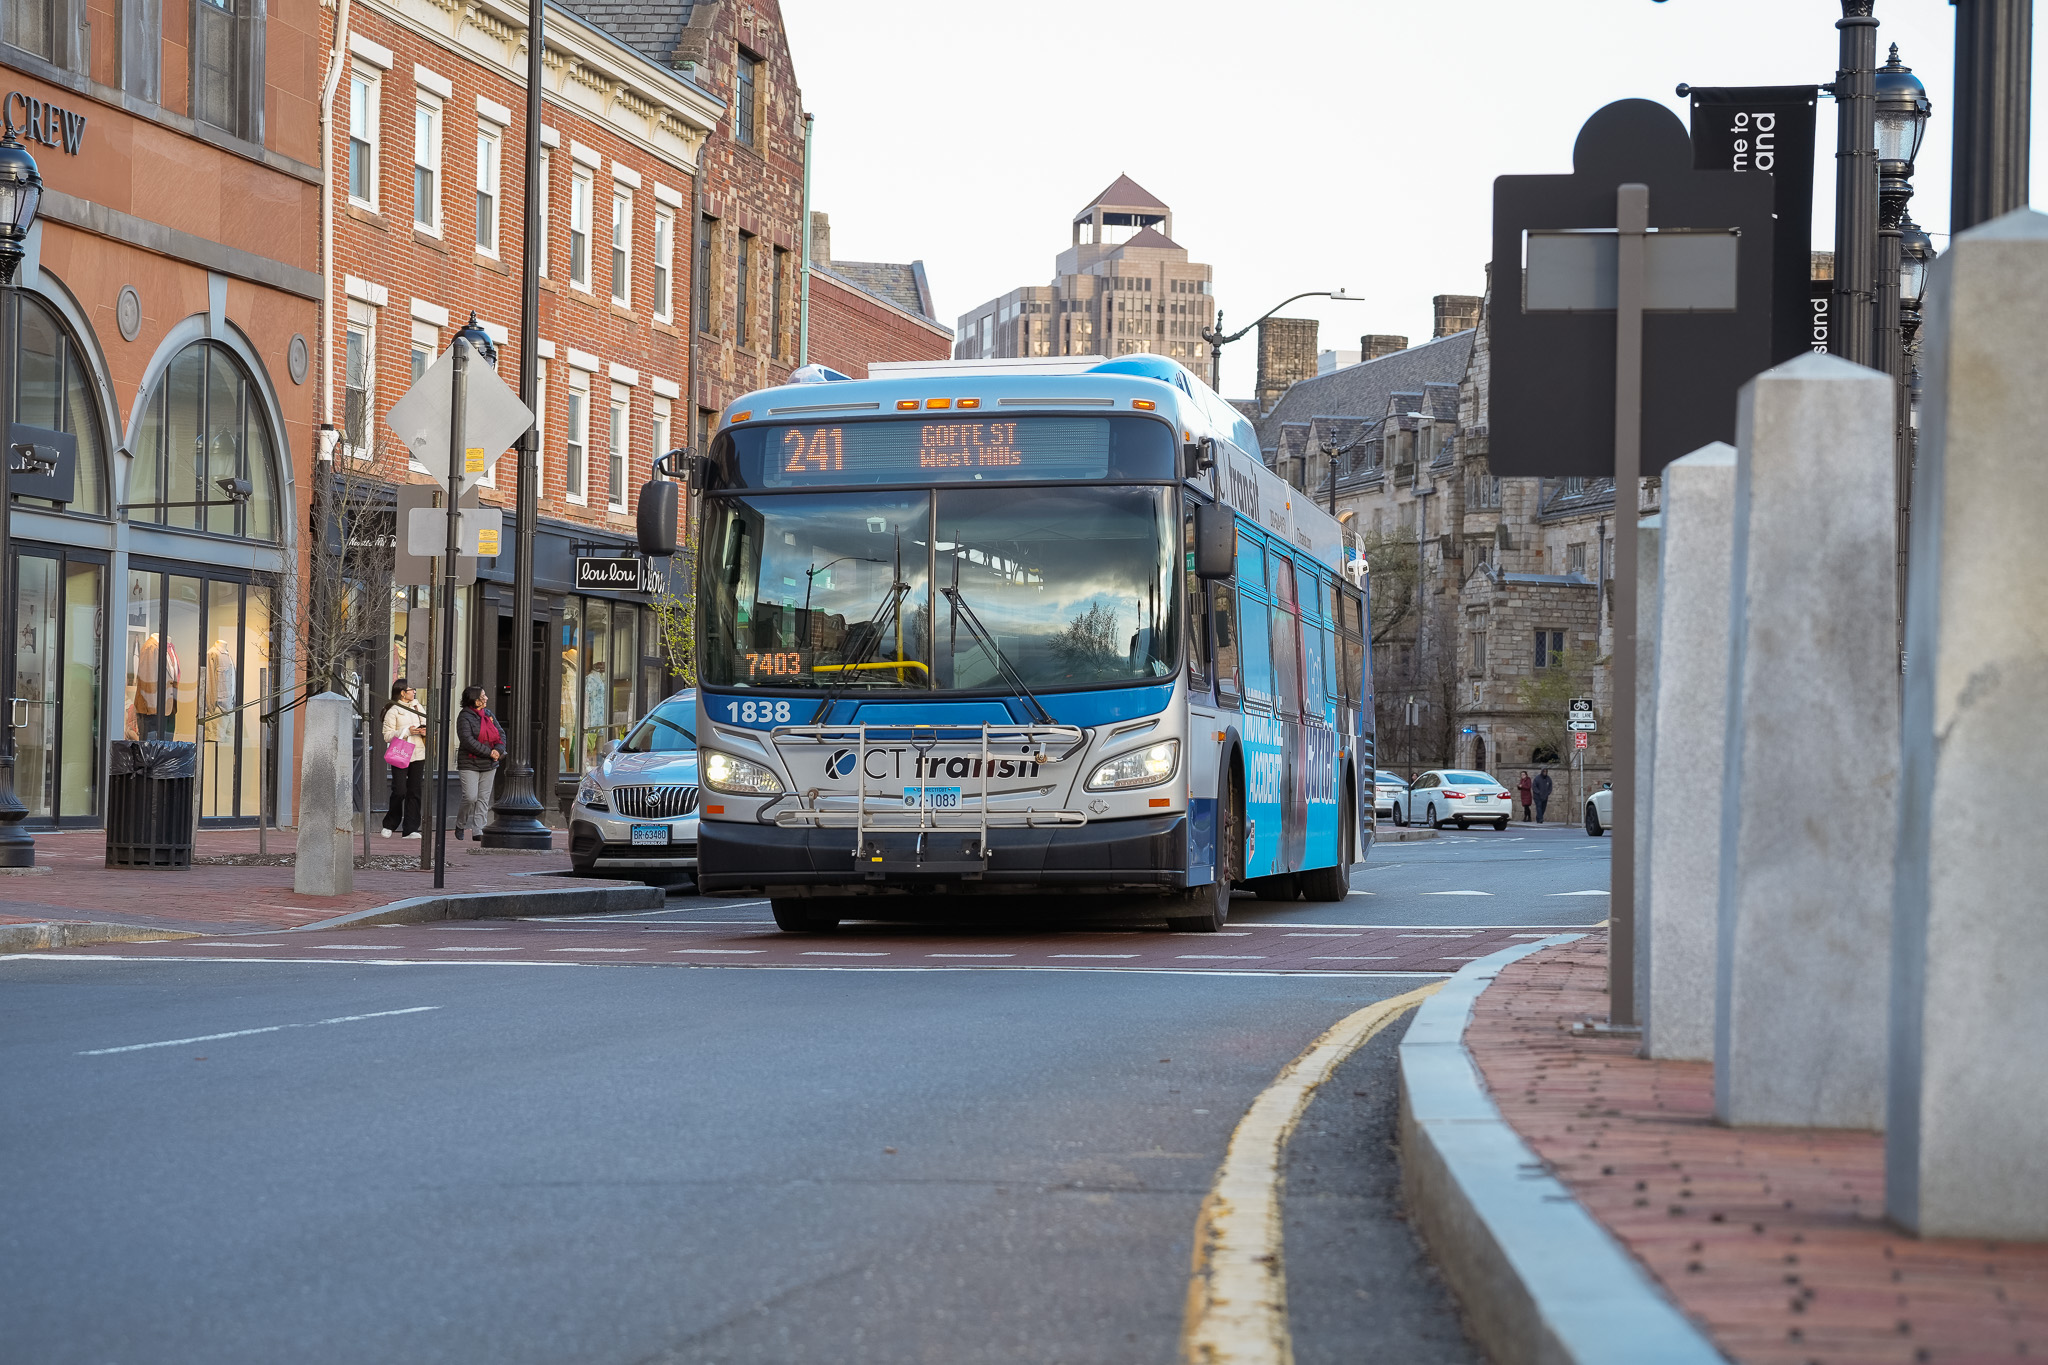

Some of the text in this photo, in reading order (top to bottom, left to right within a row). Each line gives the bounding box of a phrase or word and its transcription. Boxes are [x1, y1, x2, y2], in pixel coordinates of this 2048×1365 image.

[1730, 112, 1749, 134] to
[922, 423, 1017, 446] GOFFE ST
[784, 429, 843, 472] 241
[920, 446, 1022, 467] West Hills
[1227, 453, 1260, 524] transit
[581, 562, 608, 580] lou
[609, 562, 636, 581] lou
[746, 652, 800, 676] 7403
[726, 701, 791, 723] 1838
[864, 744, 1042, 780] CT transit
